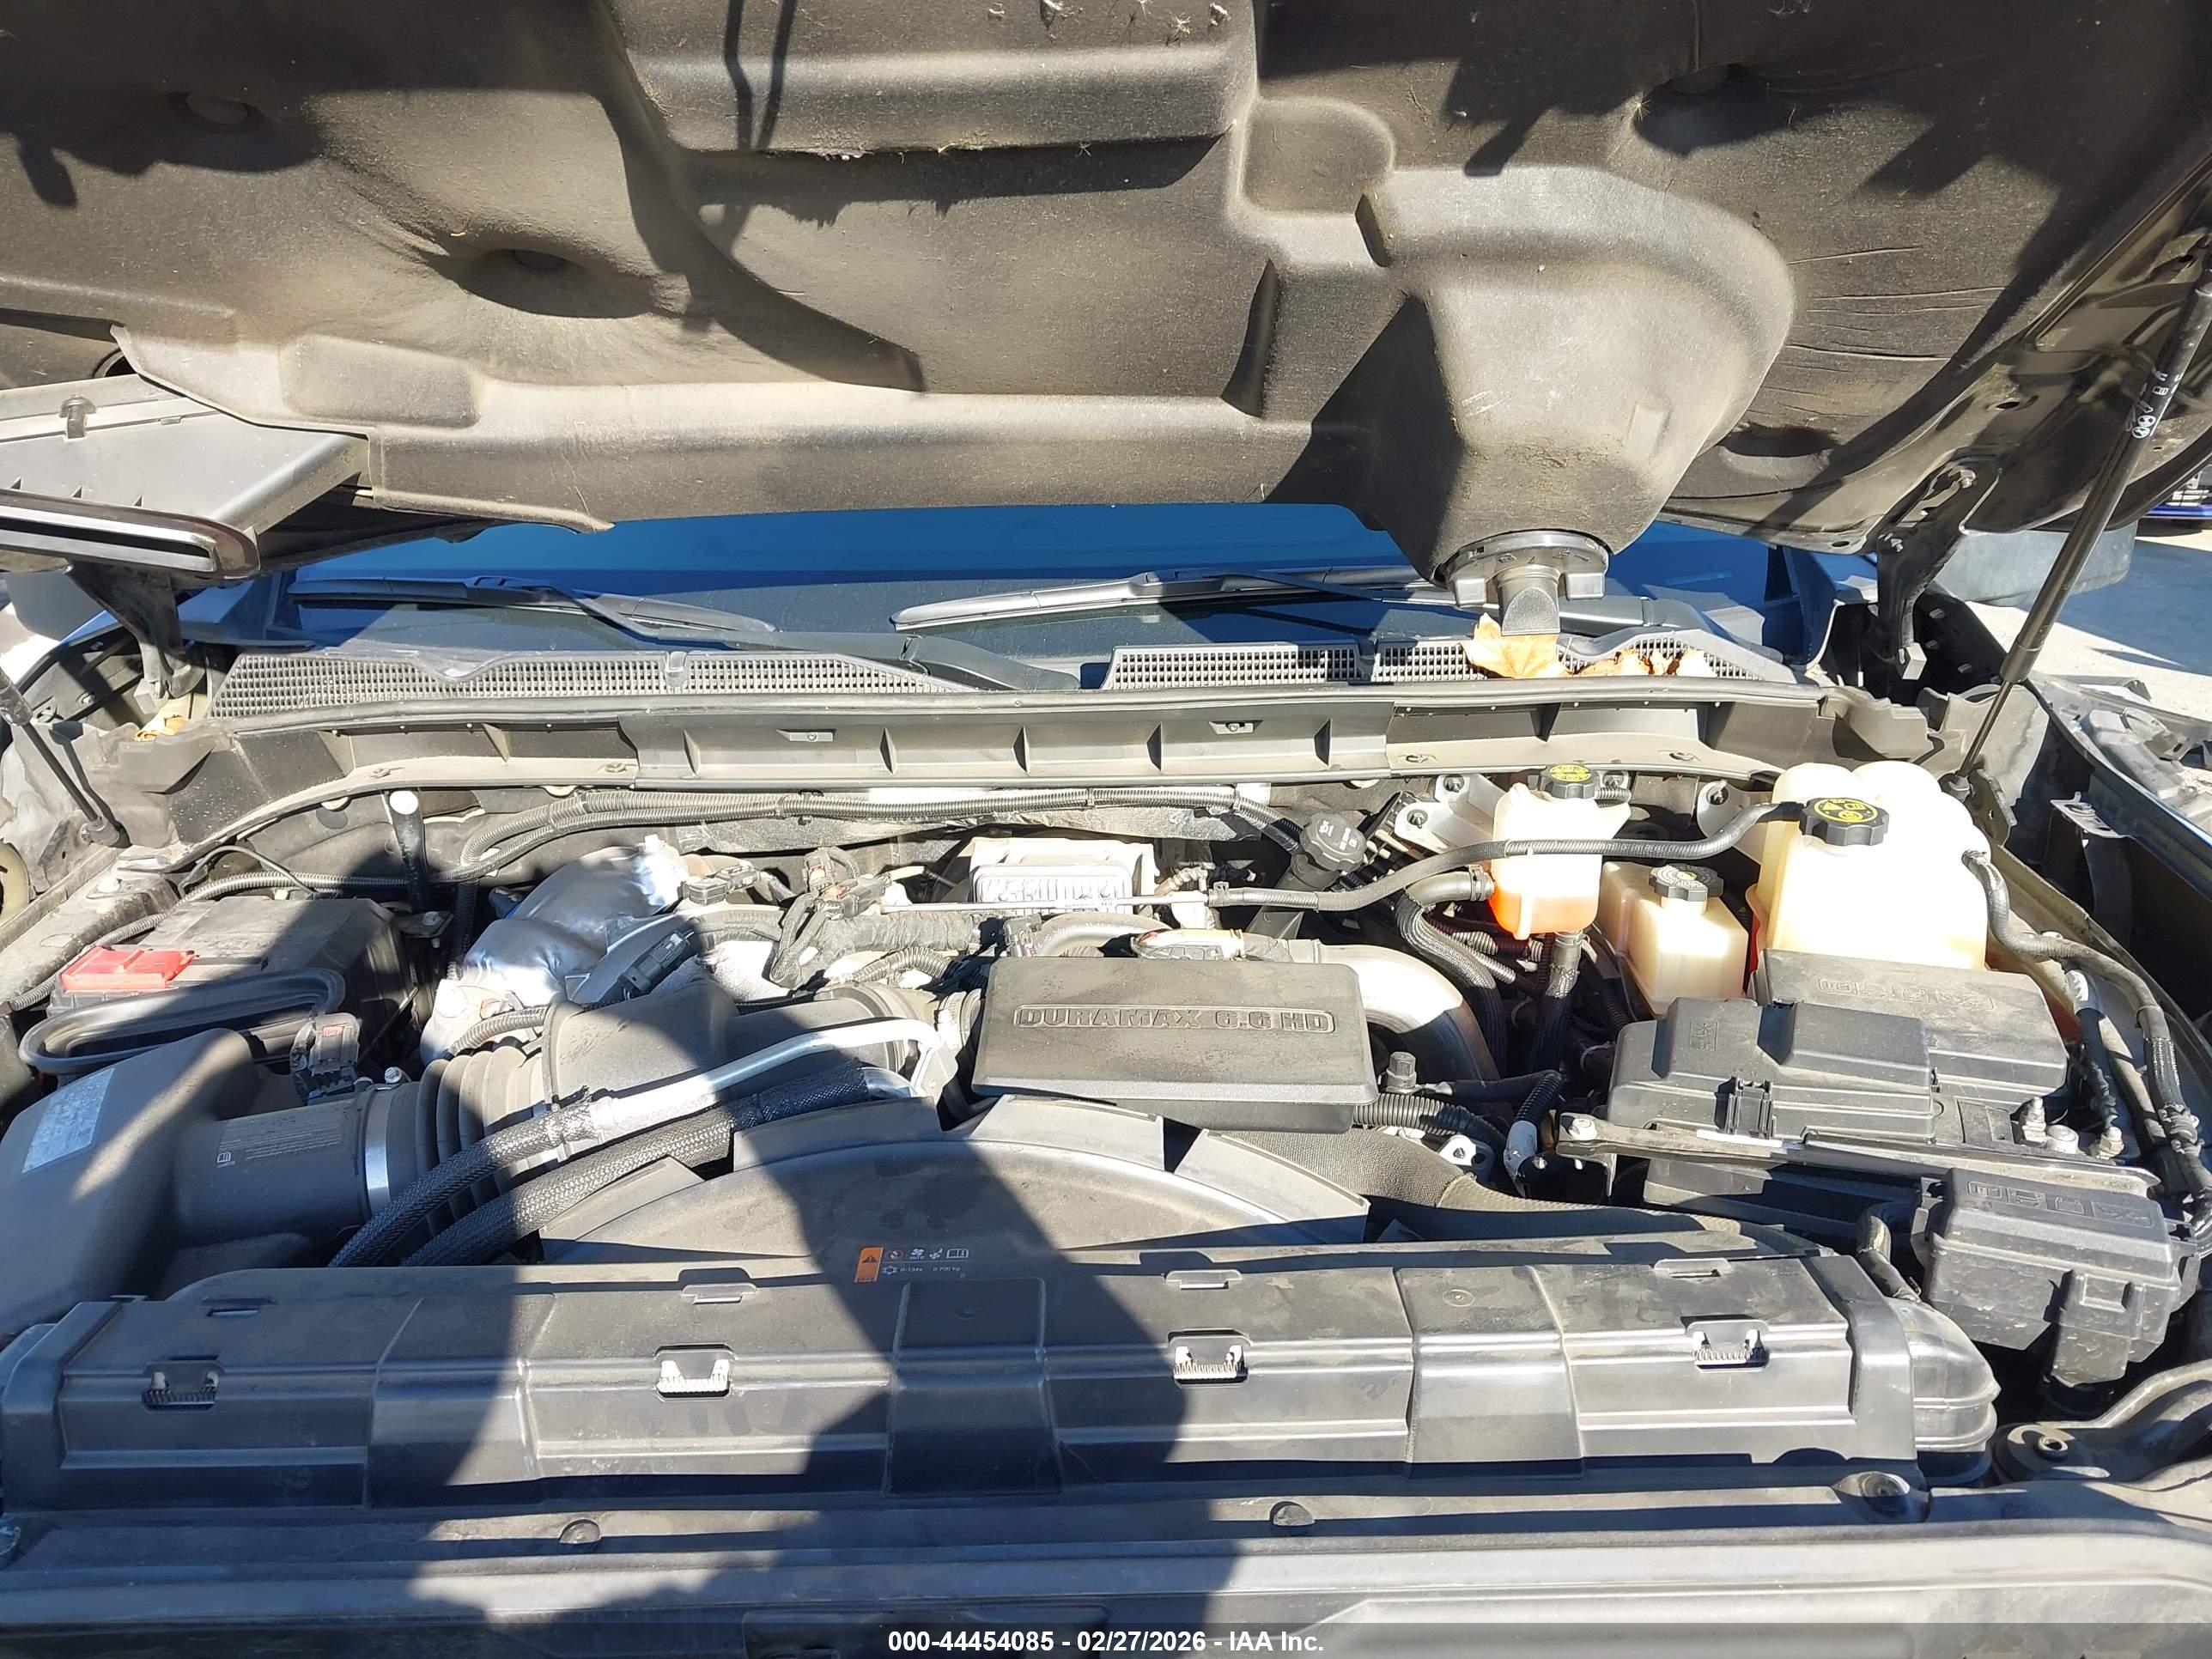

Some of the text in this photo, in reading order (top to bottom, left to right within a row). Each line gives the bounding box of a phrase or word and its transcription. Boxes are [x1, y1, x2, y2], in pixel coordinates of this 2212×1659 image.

[1018, 1007, 1328, 1030] DURAMAX 6.6 HD
